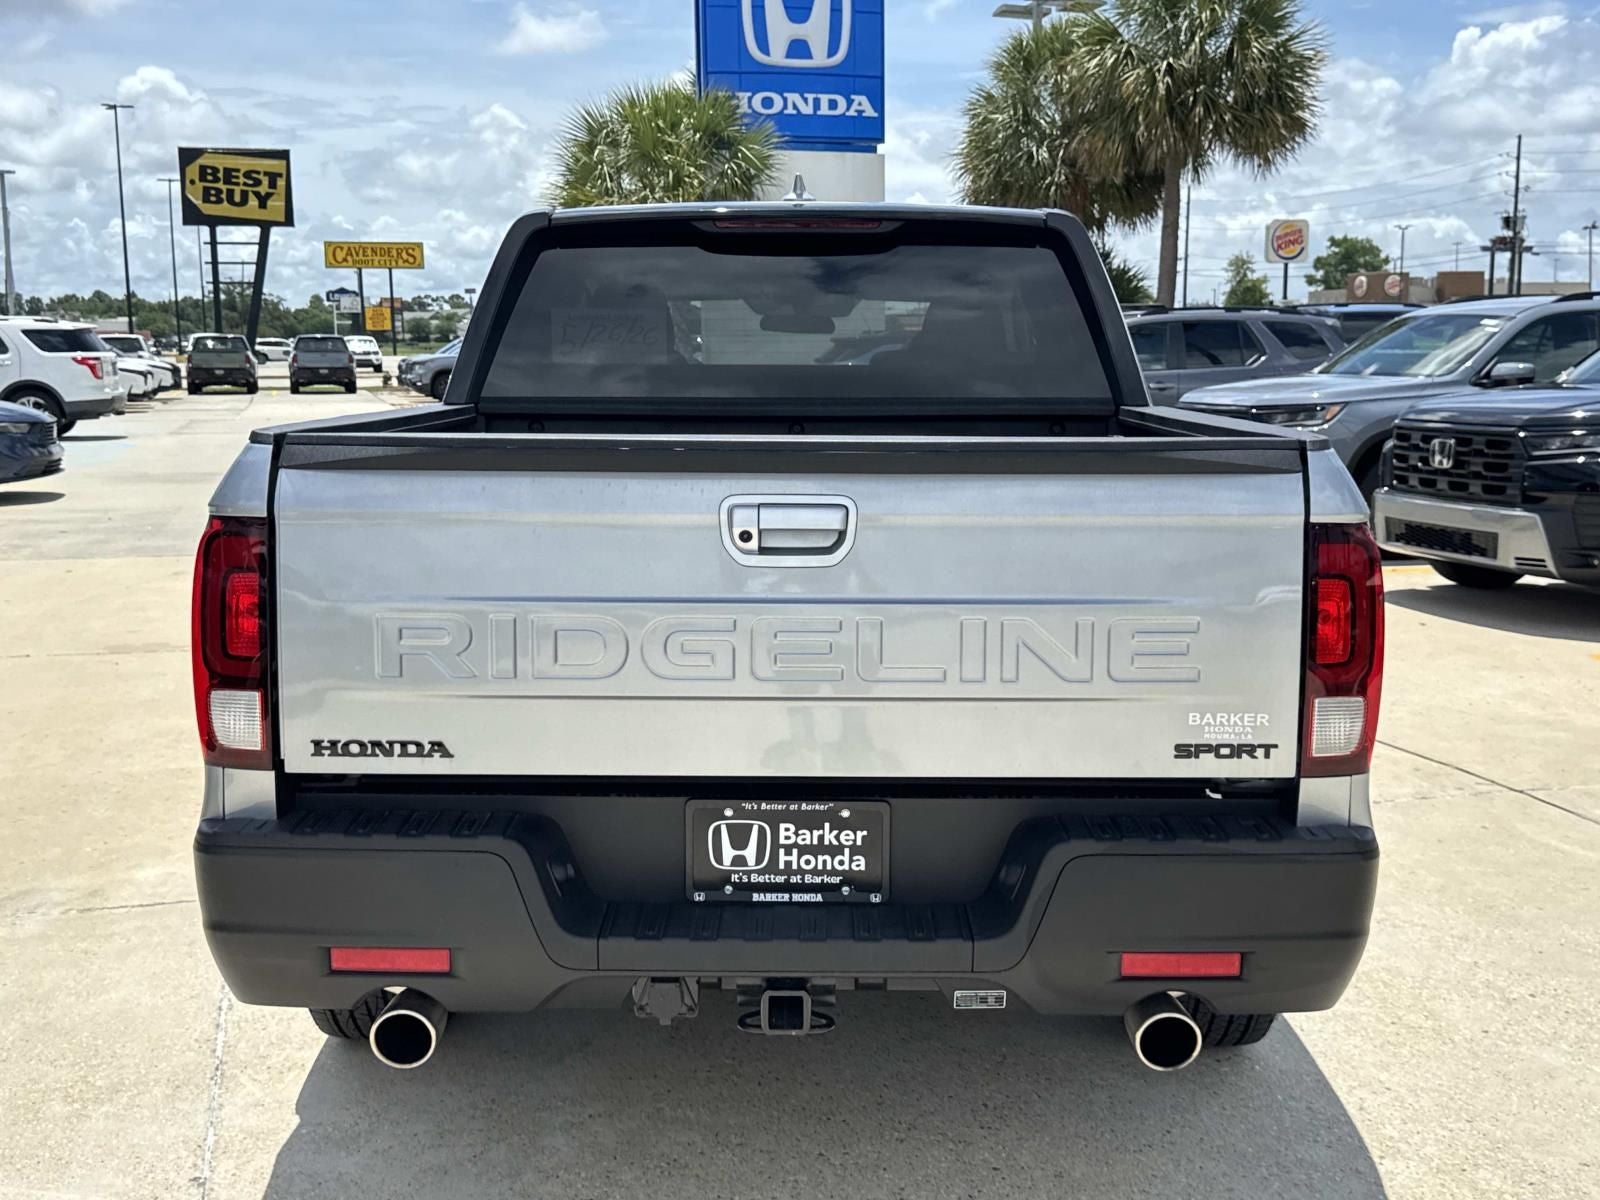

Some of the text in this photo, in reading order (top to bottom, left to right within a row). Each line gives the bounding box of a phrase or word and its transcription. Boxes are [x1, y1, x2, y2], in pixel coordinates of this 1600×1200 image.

[198, 164, 284, 190] BEST
[201, 185, 275, 210] BUY
[1276, 236, 1304, 252] KING
[332, 245, 417, 265] CAVENDER'S
[374, 612, 1202, 684] RIDGELINE
[1188, 712, 1270, 727] BARKER
[1204, 725, 1254, 733] HONDA
[310, 739, 455, 758] HONDA
[1173, 743, 1279, 760] SPORT
[760, 802, 786, 811] Better
[789, 803, 798, 811] at
[778, 822, 868, 846] Barker
[778, 848, 866, 871] Honda
[731, 872, 843, 884] It's Better at Barker
[752, 892, 823, 902] BARKER HONDA
